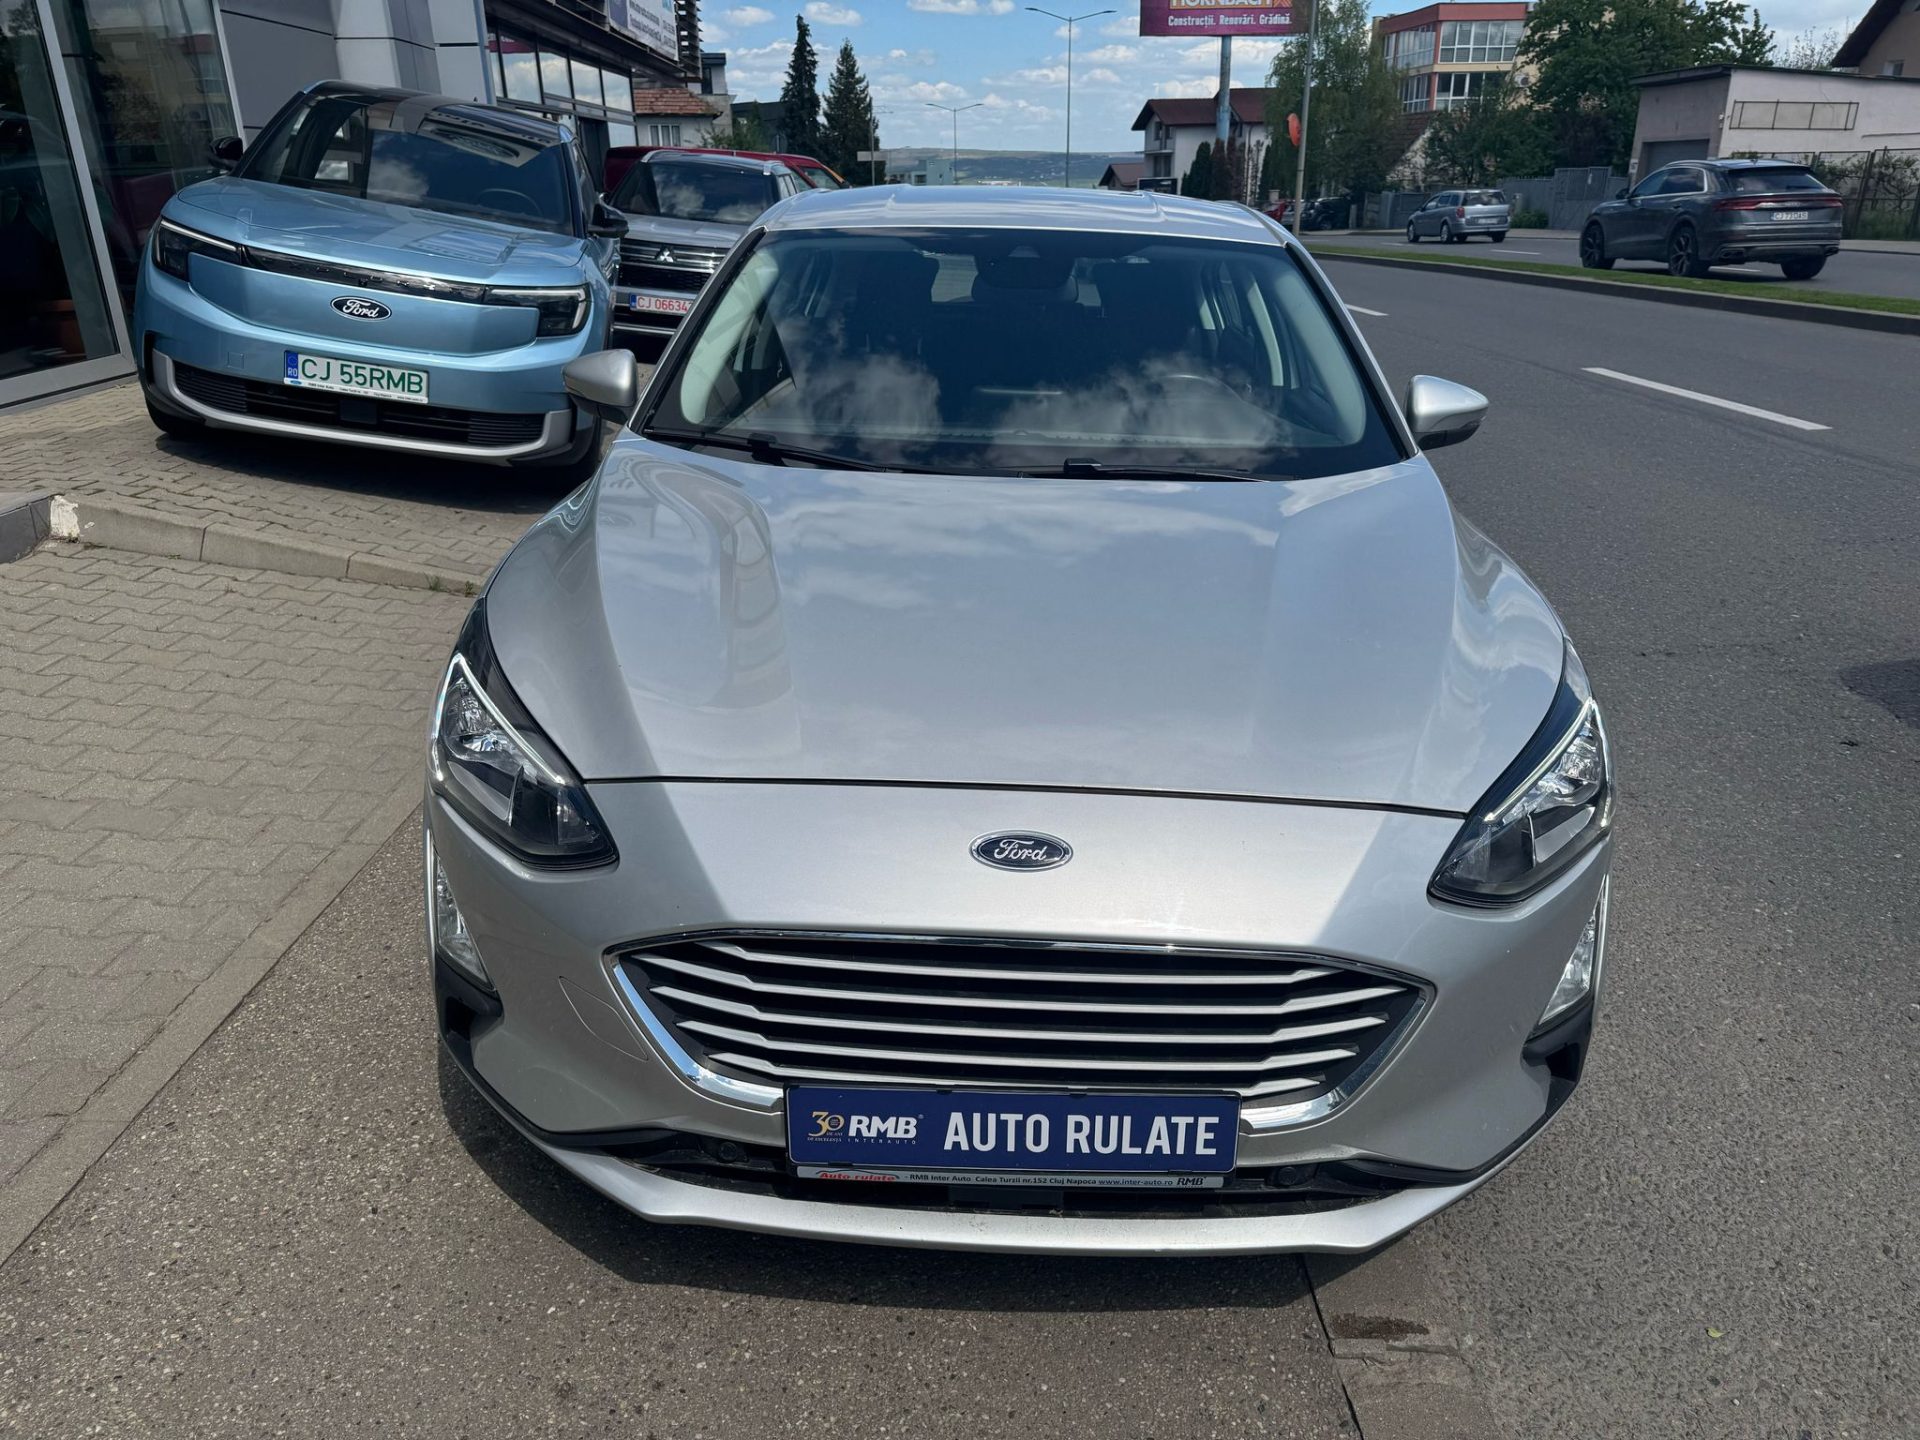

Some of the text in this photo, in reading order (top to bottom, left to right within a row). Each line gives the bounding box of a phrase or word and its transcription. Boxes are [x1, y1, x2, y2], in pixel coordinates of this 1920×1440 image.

[1219, 13, 1256, 25] Renovări.
[1259, 13, 1292, 25] Grădină.
[342, 299, 380, 319] Ford
[638, 296, 651, 309] CJ
[287, 366, 298, 377] RO
[301, 358, 331, 381] CJ
[994, 839, 1048, 861] Ford
[808, 1111, 1220, 1156] 30 RMB AUTO RULATE
[820, 1172, 896, 1181] Auto rulate
[1000, 1176, 1021, 1184] Turzii
[1050, 1177, 1065, 1186] Cluj
[1067, 1178, 1097, 1186] Napoca
[1099, 1178, 1173, 1186] www.inter-auto.ro
[1177, 1177, 1204, 1186] RMB
